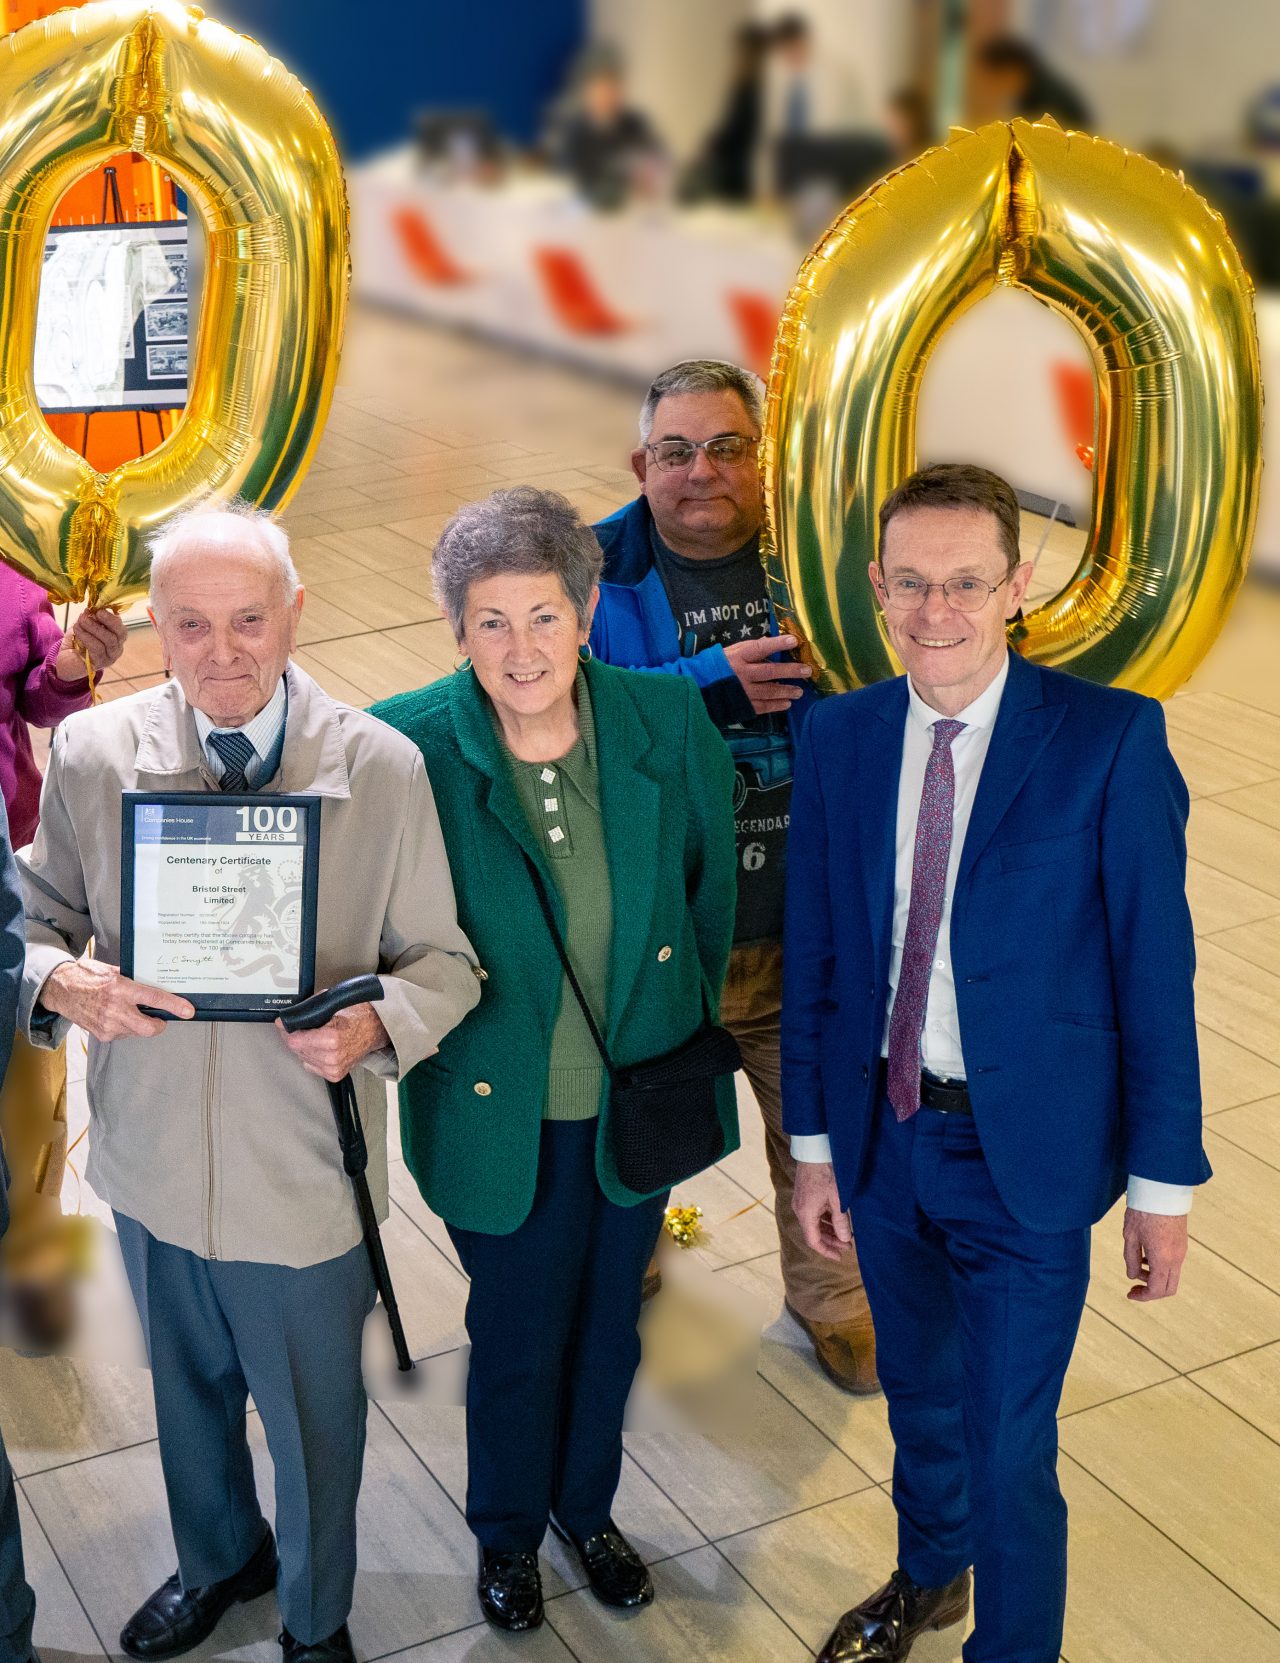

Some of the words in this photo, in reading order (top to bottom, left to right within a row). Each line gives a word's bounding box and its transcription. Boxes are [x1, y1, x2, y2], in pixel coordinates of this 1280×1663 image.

[684, 609, 707, 627] I'M
[711, 605, 740, 621] NOT
[236, 807, 298, 832] 100
[166, 855, 218, 866] Centenary
[220, 856, 272, 865] Certificate
[214, 867, 223, 875] of
[192, 885, 220, 893] Bristol
[221, 885, 246, 893] Street
[203, 896, 235, 904] Limited
[162, 938, 178, 946] today
